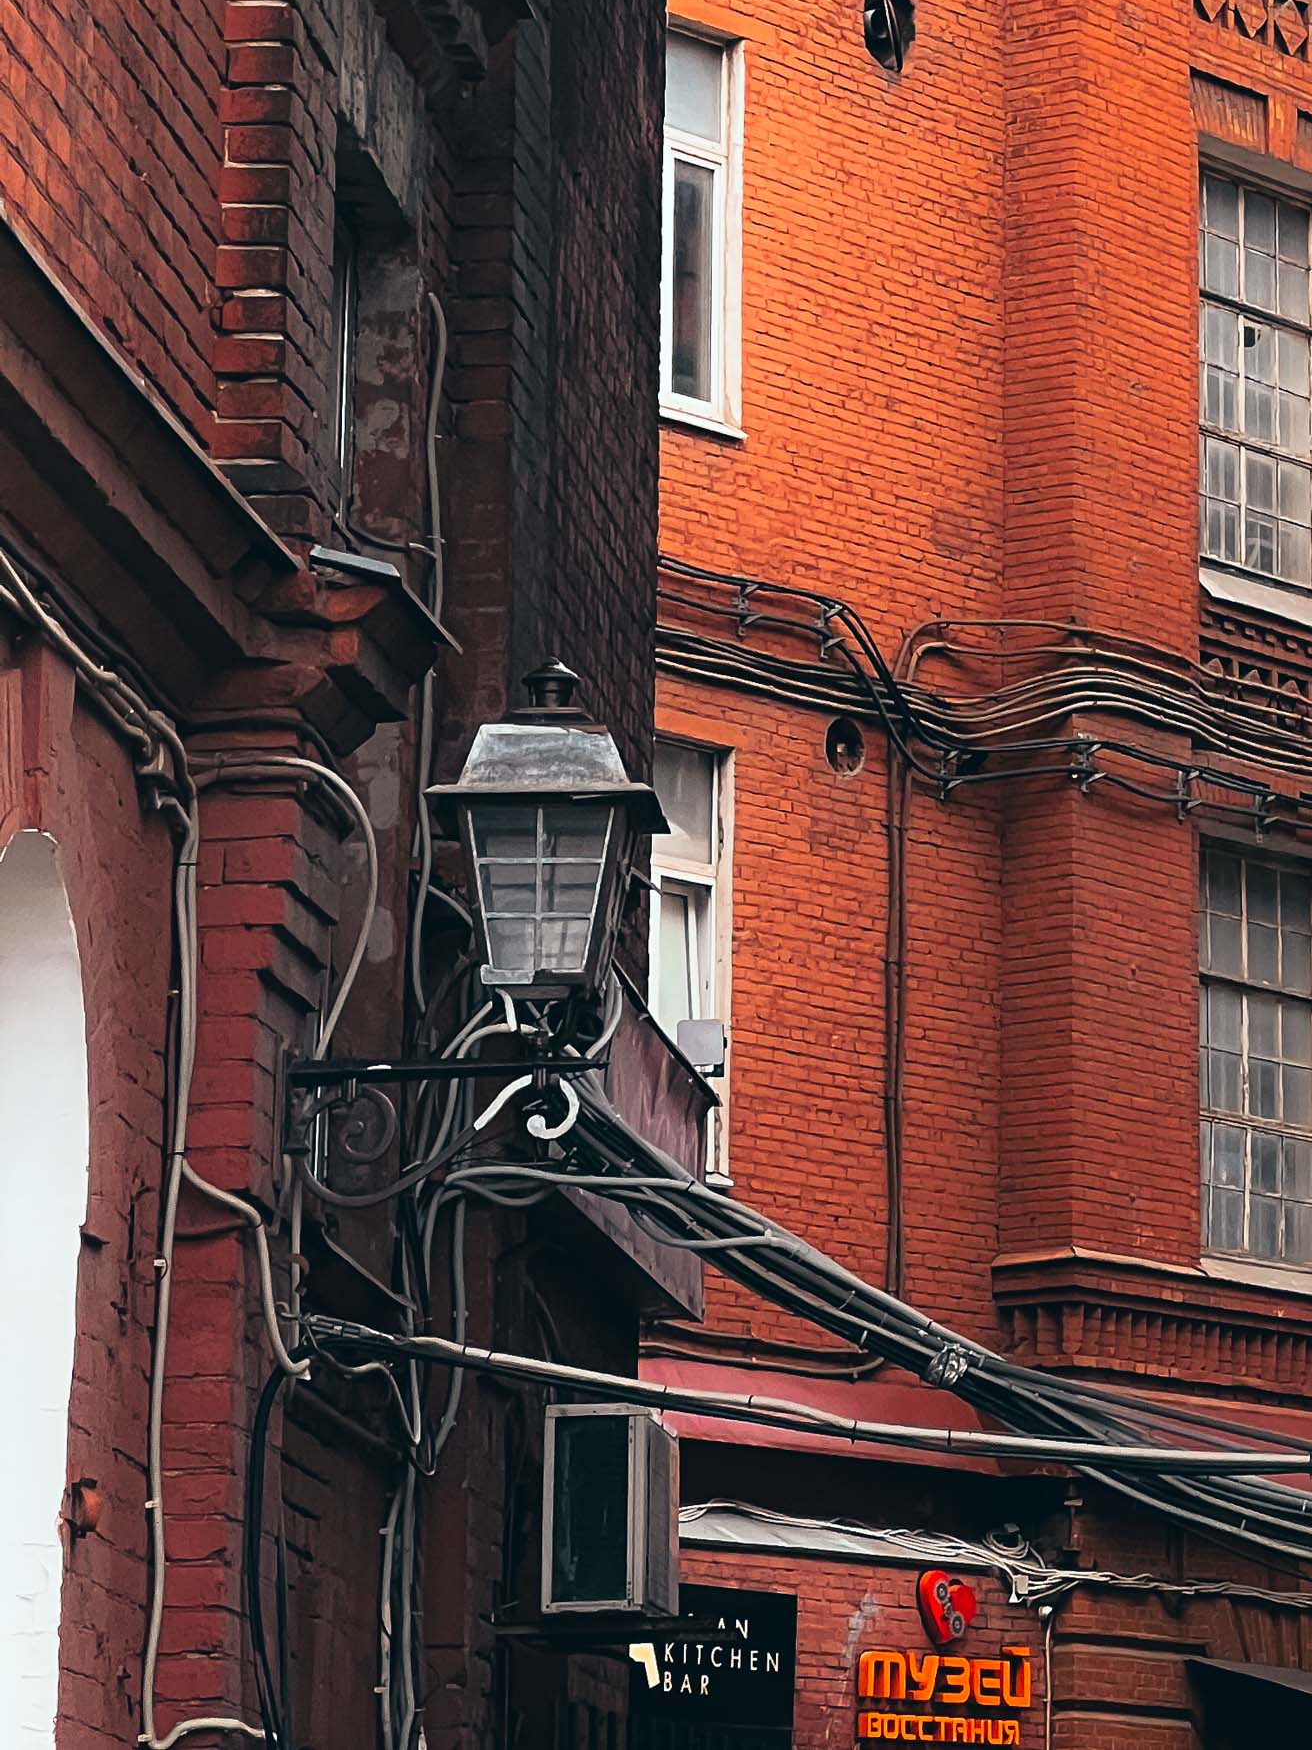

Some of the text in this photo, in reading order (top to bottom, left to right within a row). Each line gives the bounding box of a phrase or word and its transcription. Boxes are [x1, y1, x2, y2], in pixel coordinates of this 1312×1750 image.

[664, 1642, 780, 1672] KITCHEN
[663, 1671, 710, 1695] BAR
[858, 1646, 1032, 1707] МУЗЕЙ
[859, 1712, 1020, 1746] ВОССТАНИЯ
